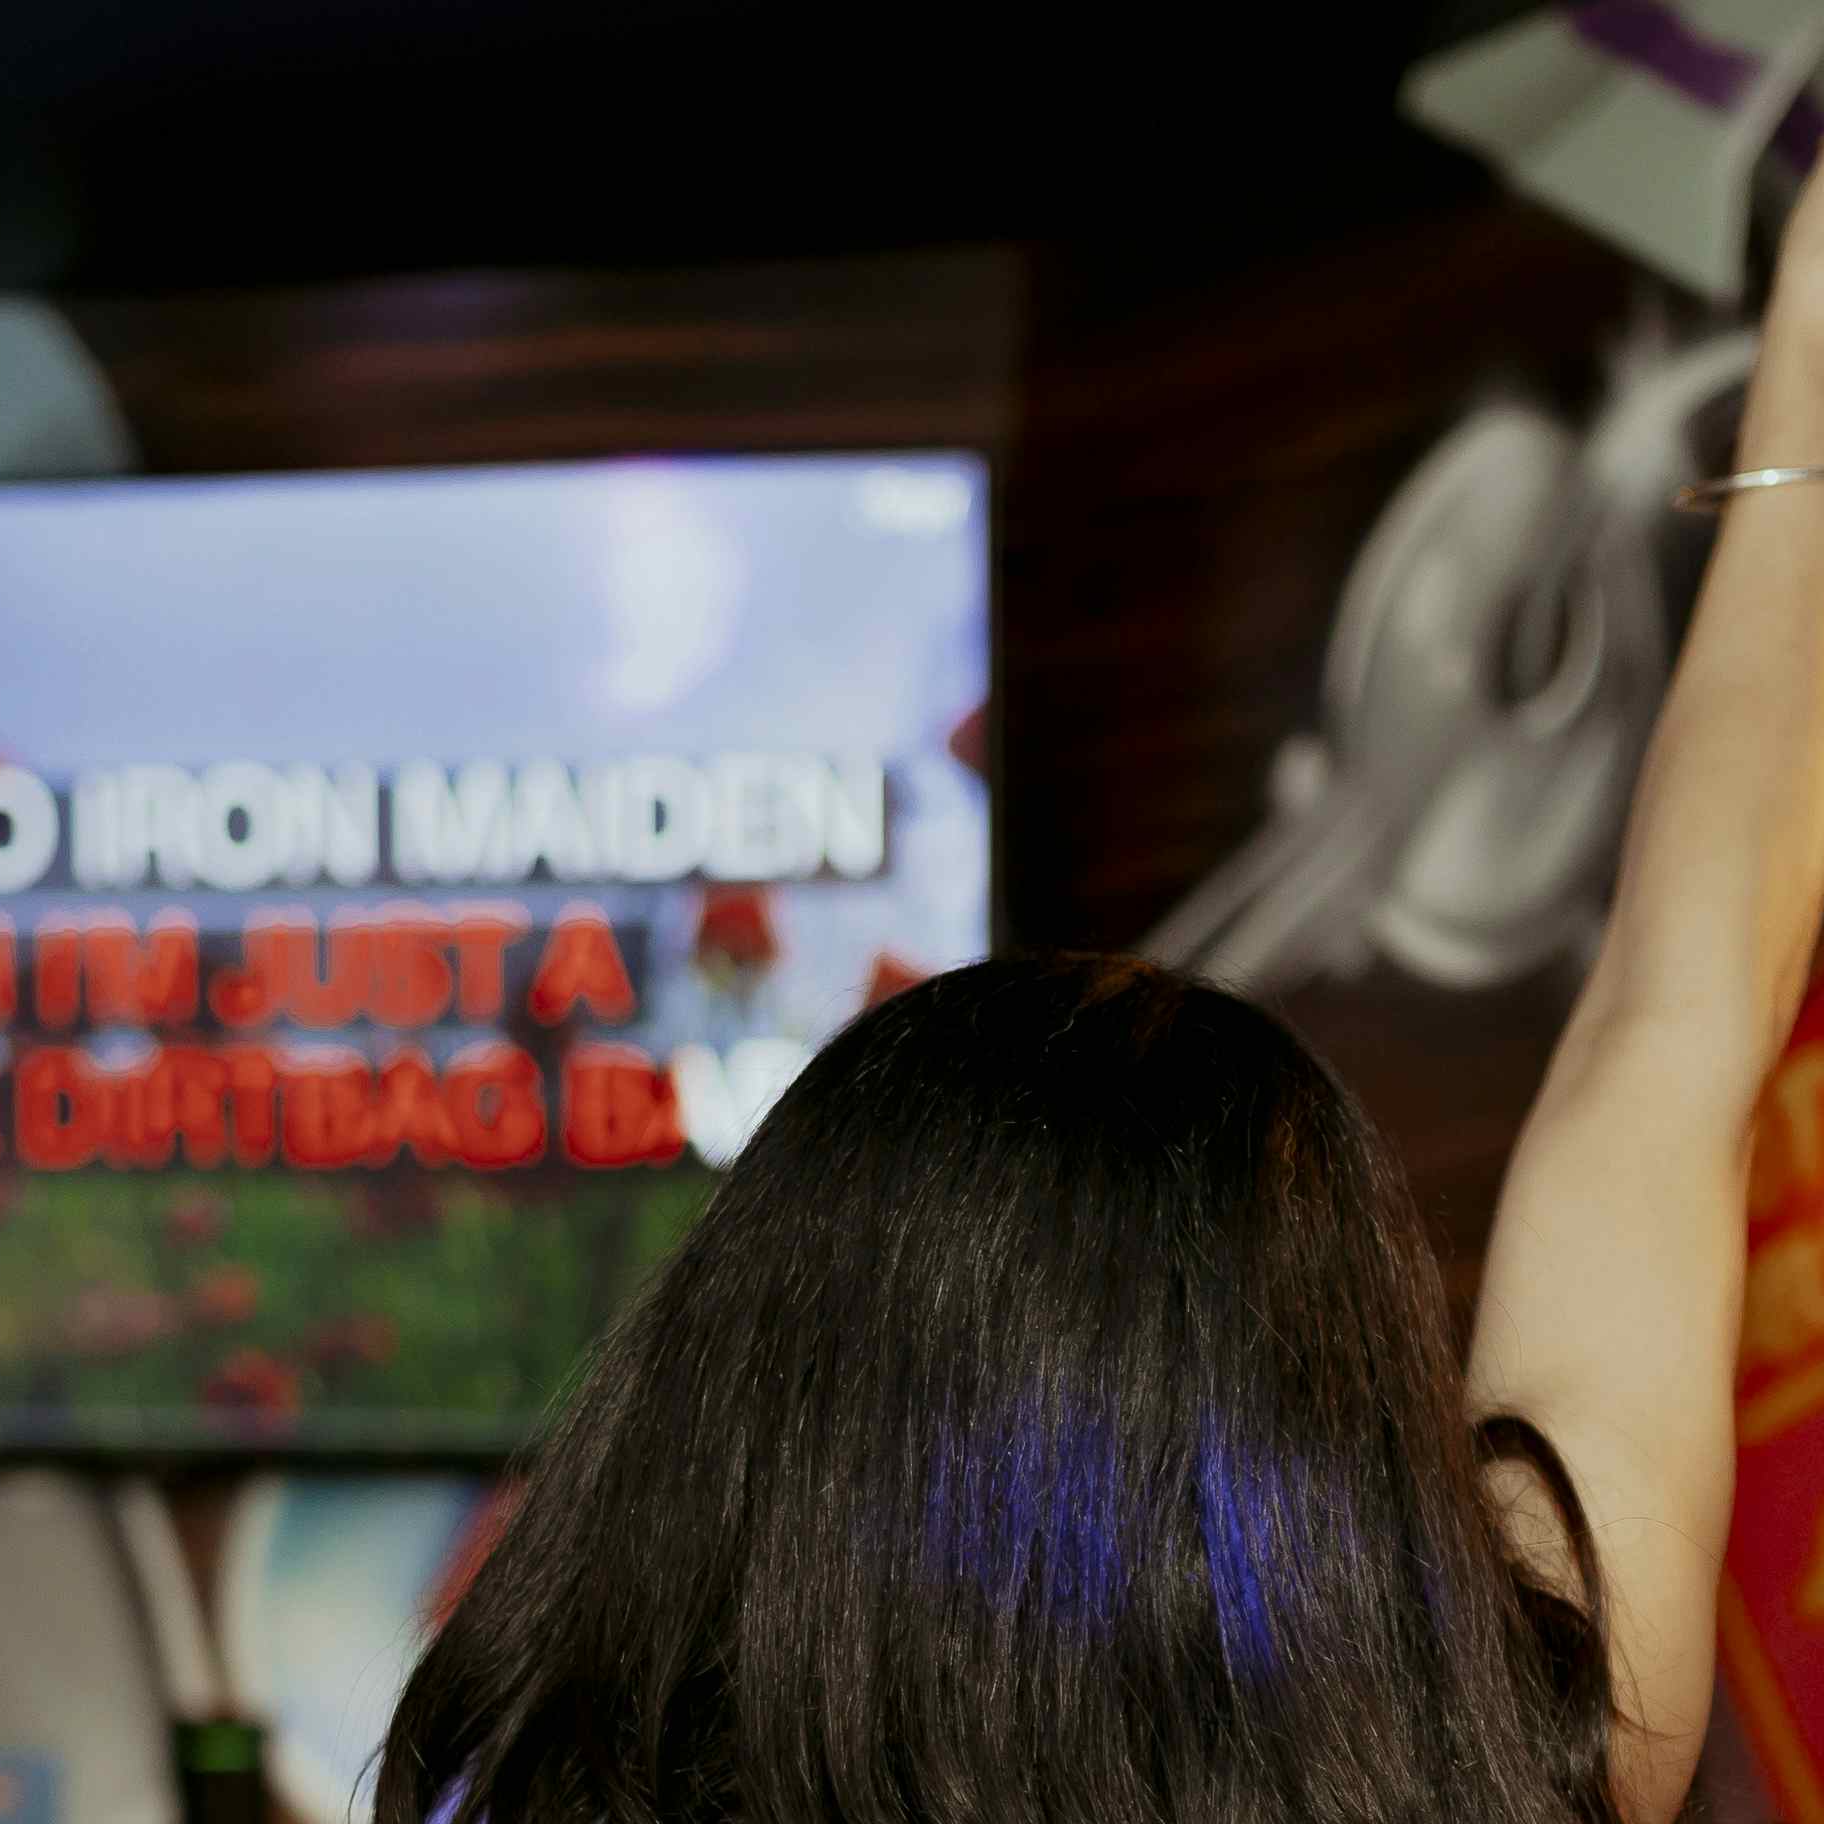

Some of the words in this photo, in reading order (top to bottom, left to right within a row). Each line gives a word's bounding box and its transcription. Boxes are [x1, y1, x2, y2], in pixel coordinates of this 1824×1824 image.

[69, 762, 379, 893] IRON
[390, 752, 886, 888] MAIDEN
[207, 901, 533, 1031] JUST
[528, 900, 635, 1028] A
[14, 1036, 547, 1172] DIRTBAG
